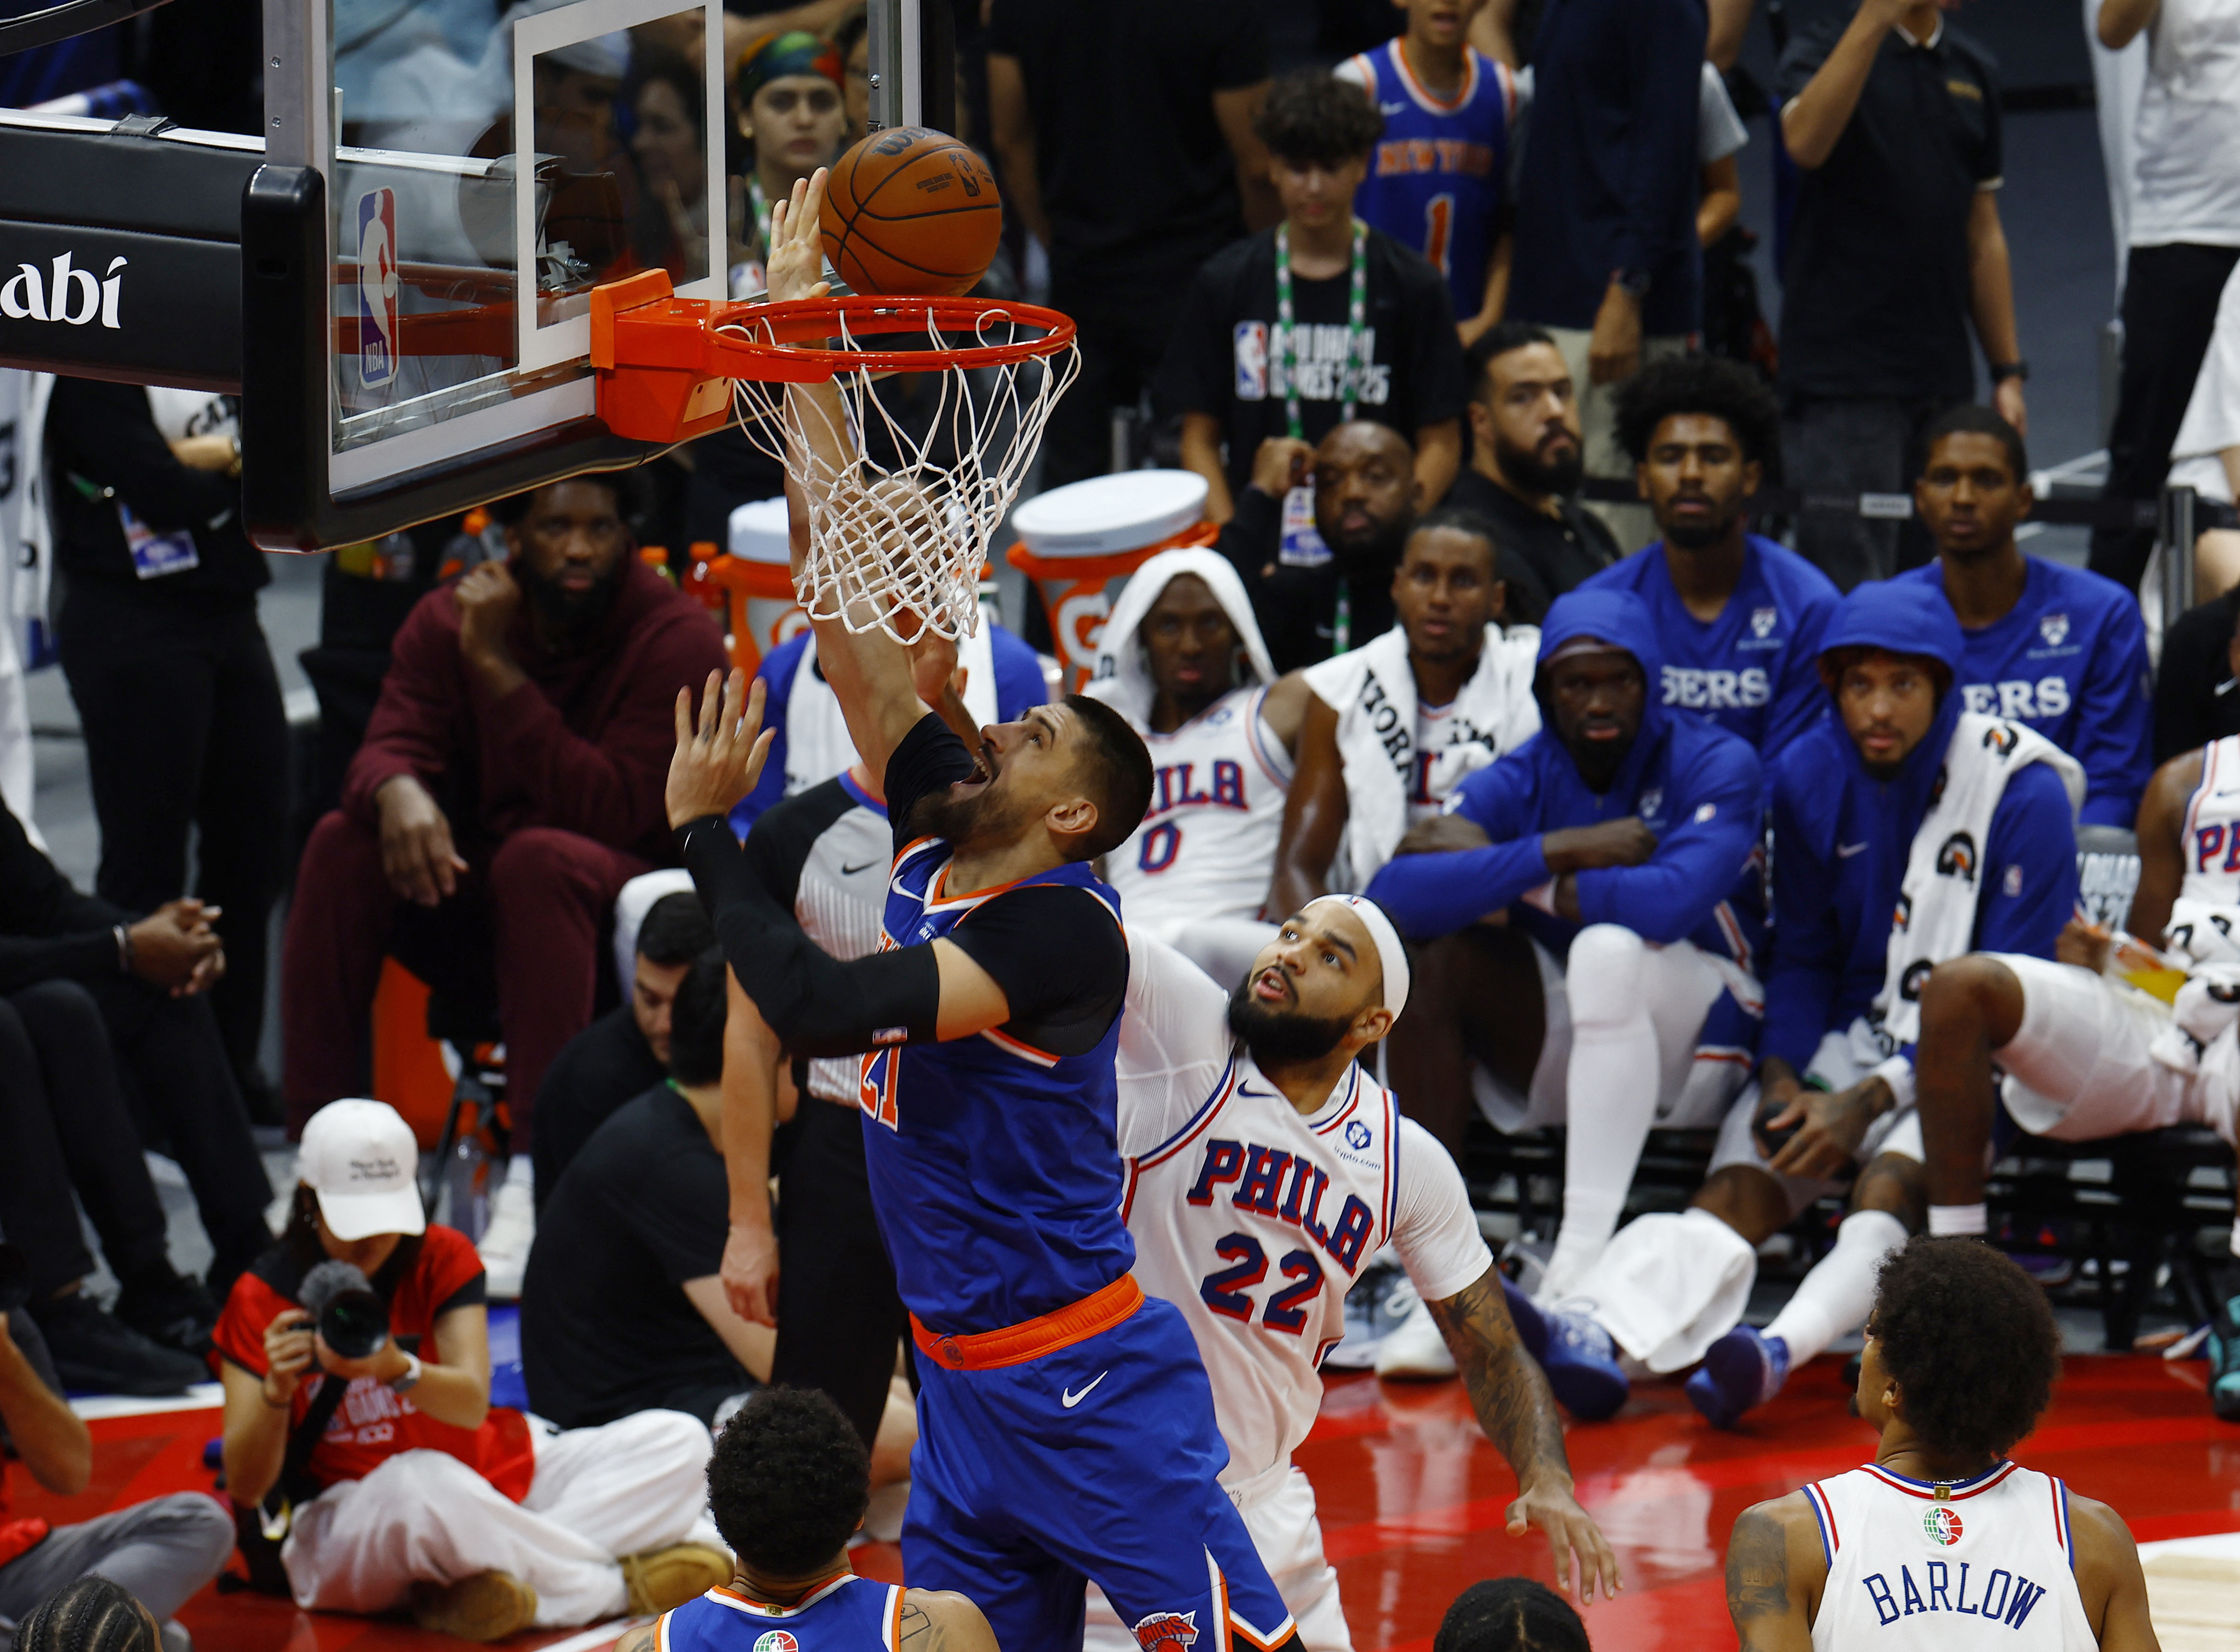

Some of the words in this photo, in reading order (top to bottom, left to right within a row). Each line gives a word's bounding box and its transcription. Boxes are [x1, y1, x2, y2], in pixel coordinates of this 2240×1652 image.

[1424, 193, 1454, 280] 1
[0, 250, 128, 329] abí
[365, 340, 384, 374] NBA
[1144, 760, 1252, 820] ILA
[1139, 819, 1184, 876] 0
[1187, 1139, 1375, 1278] PHILA
[1200, 1231, 1326, 1337] 22
[1862, 1561, 2046, 1630] BARLOW
[1137, 1616, 1197, 1647] KNICKS
